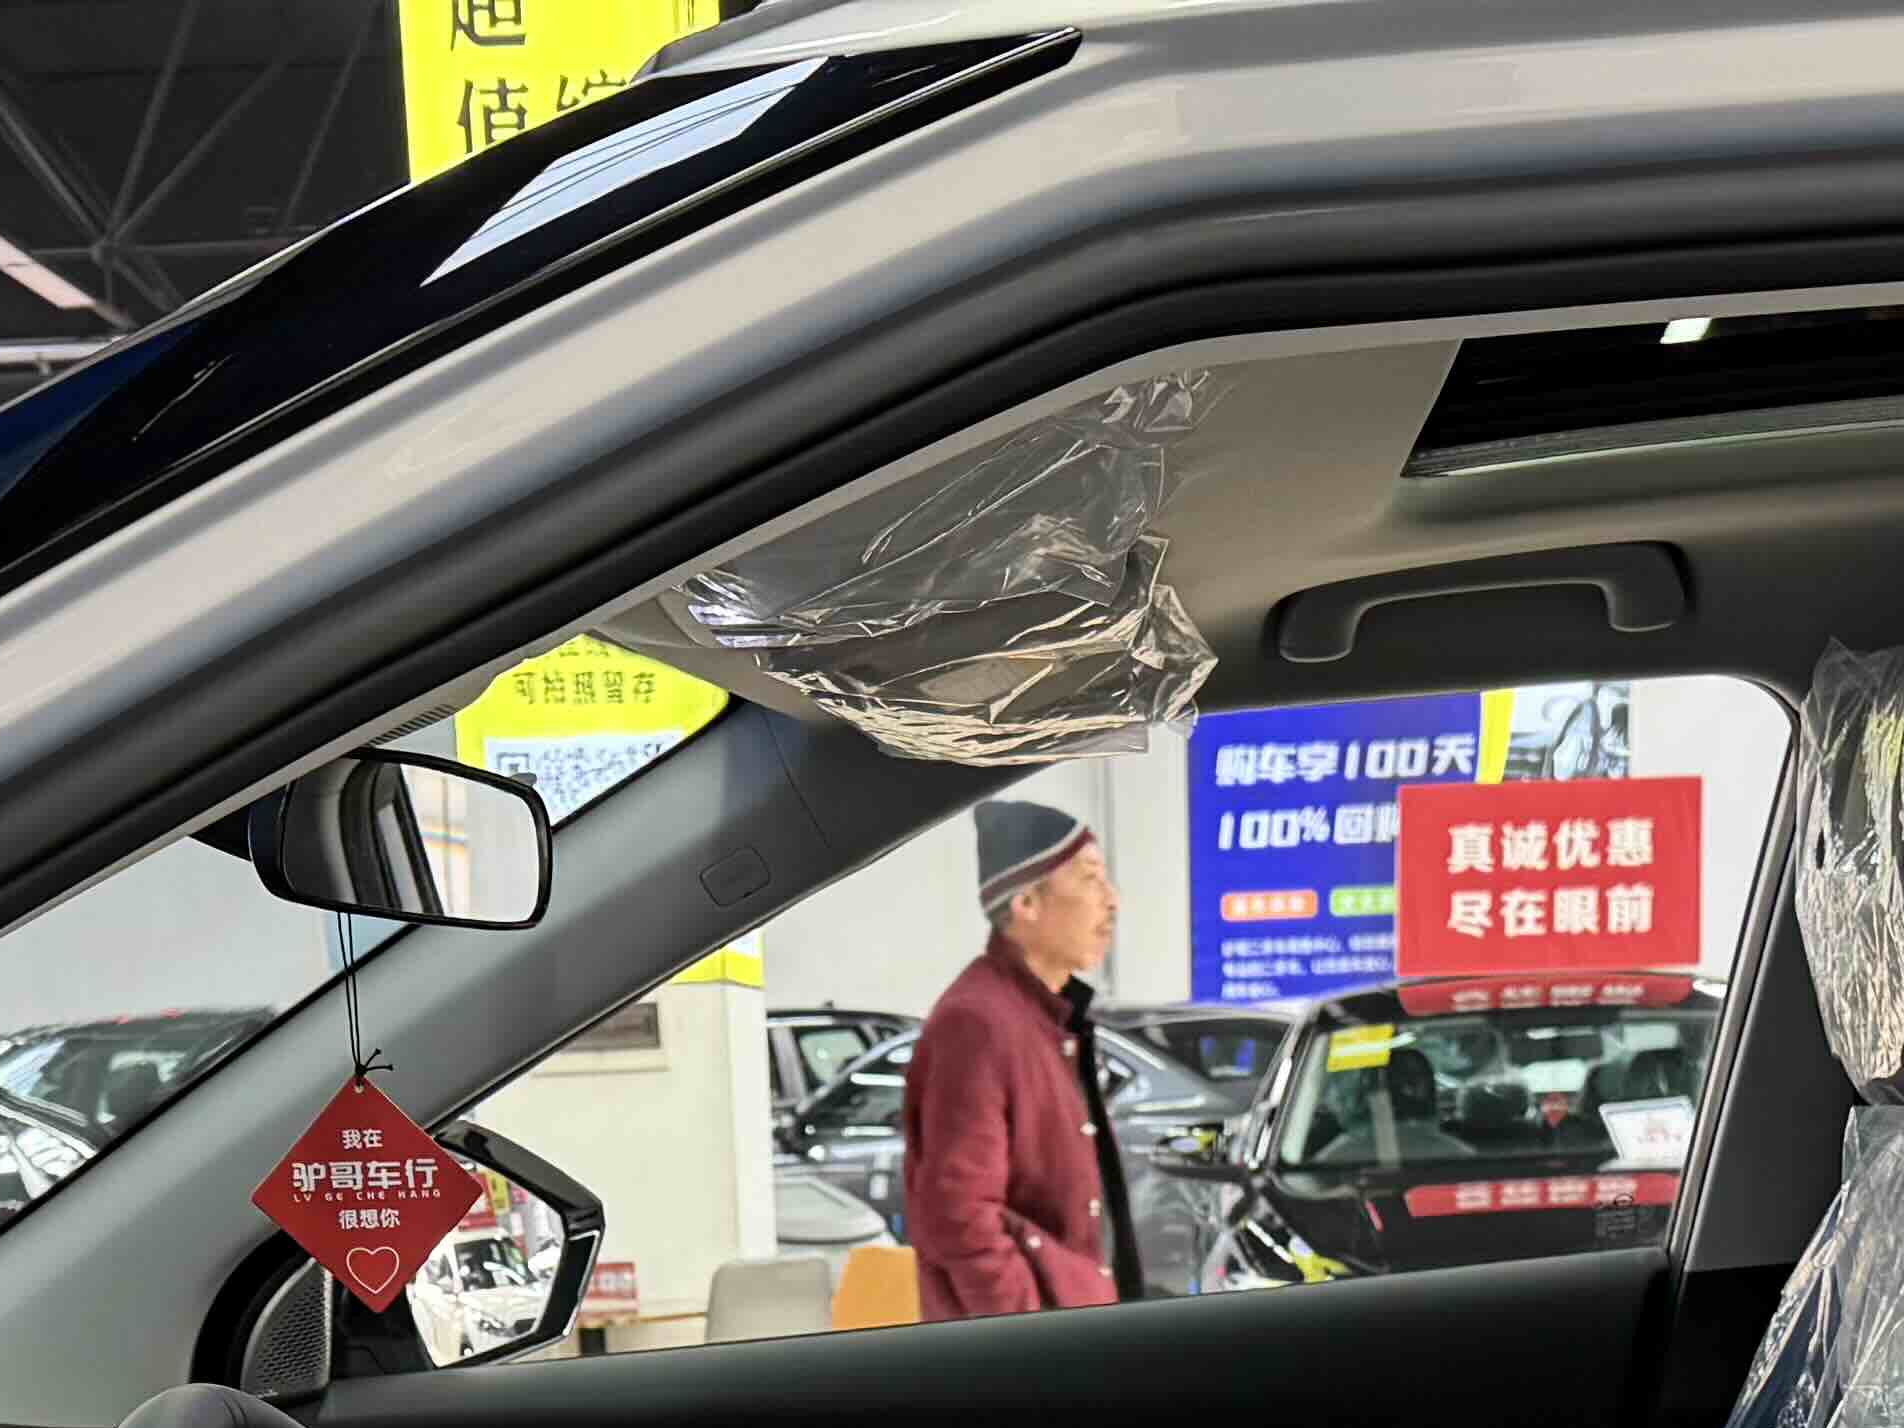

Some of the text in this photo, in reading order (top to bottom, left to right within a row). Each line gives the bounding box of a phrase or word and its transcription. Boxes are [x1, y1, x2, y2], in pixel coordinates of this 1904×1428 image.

[1446, 816, 1655, 875] 真诚优惠
[1446, 883, 1655, 939] 尽在眼前
[341, 1128, 384, 1150] 我在
[291, 1158, 439, 1192] 驴哥车行
[356, 1190, 385, 1200] CHE
[398, 1189, 441, 1199] HANG
[339, 1208, 401, 1230] 很想你
